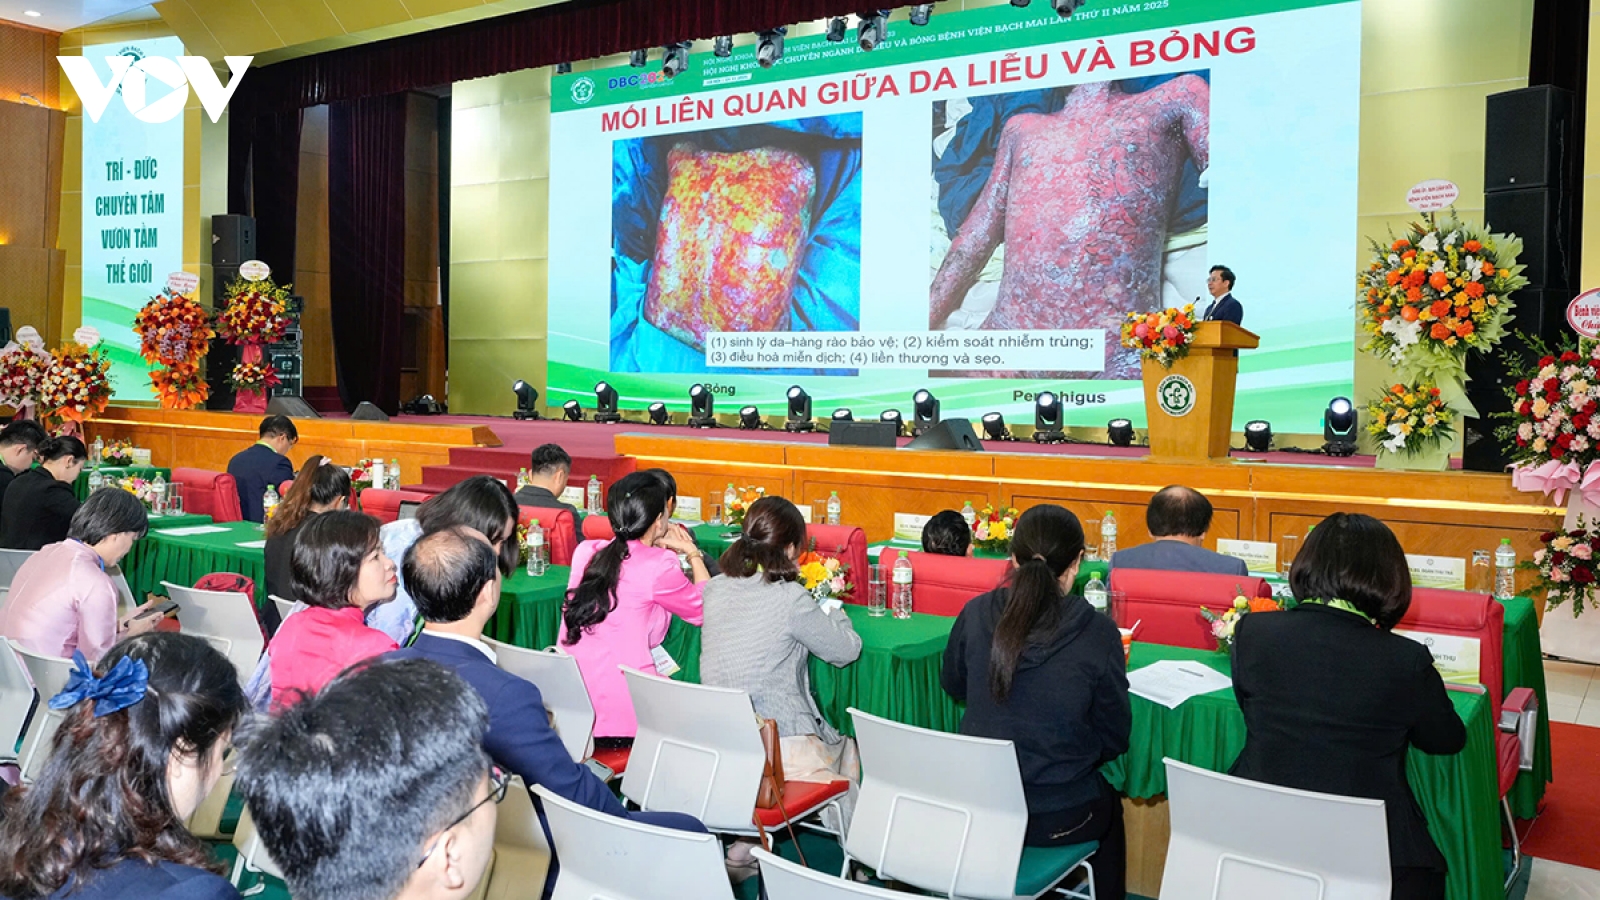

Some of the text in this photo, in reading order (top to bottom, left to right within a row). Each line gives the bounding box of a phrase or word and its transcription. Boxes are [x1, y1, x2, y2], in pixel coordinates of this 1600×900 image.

[1025, 17, 1048, 29] MAI
[1144, 0, 1169, 11] 2025
[601, 26, 1256, 132] MỐI LIÊN QUAN GIỮA DA LIỄU VÀ BỎNG
[105, 157, 124, 181] TRÍ
[134, 155, 157, 180] ĐỨC
[95, 190, 164, 216] CHUYÊN TÂM
[101, 221, 157, 249] VƯƠN TẦM
[106, 256, 126, 284] THẾ
[129, 259, 153, 283] GIỚI
[711, 336, 727, 348] (1)
[730, 337, 753, 347] sinh
[757, 337, 766, 349] lý
[826, 336, 847, 348] rào
[851, 335, 875, 348] bảo
[879, 335, 899, 349] vệ;
[903, 335, 922, 349] (2)
[926, 333, 960, 348] kiểm
[963, 335, 994, 348] soát
[999, 333, 1045, 348] nhiễm
[1049, 335, 1094, 350] trùng;
[711, 351, 727, 364] (3)
[729, 349, 754, 362] điều
[783, 350, 813, 363] miễn
[816, 352, 846, 365] dịch;
[850, 352, 868, 365] (4)
[872, 350, 894, 364] liền
[899, 352, 949, 366] thương
[953, 352, 970, 364] và
[974, 354, 1005, 366] sẹo.
